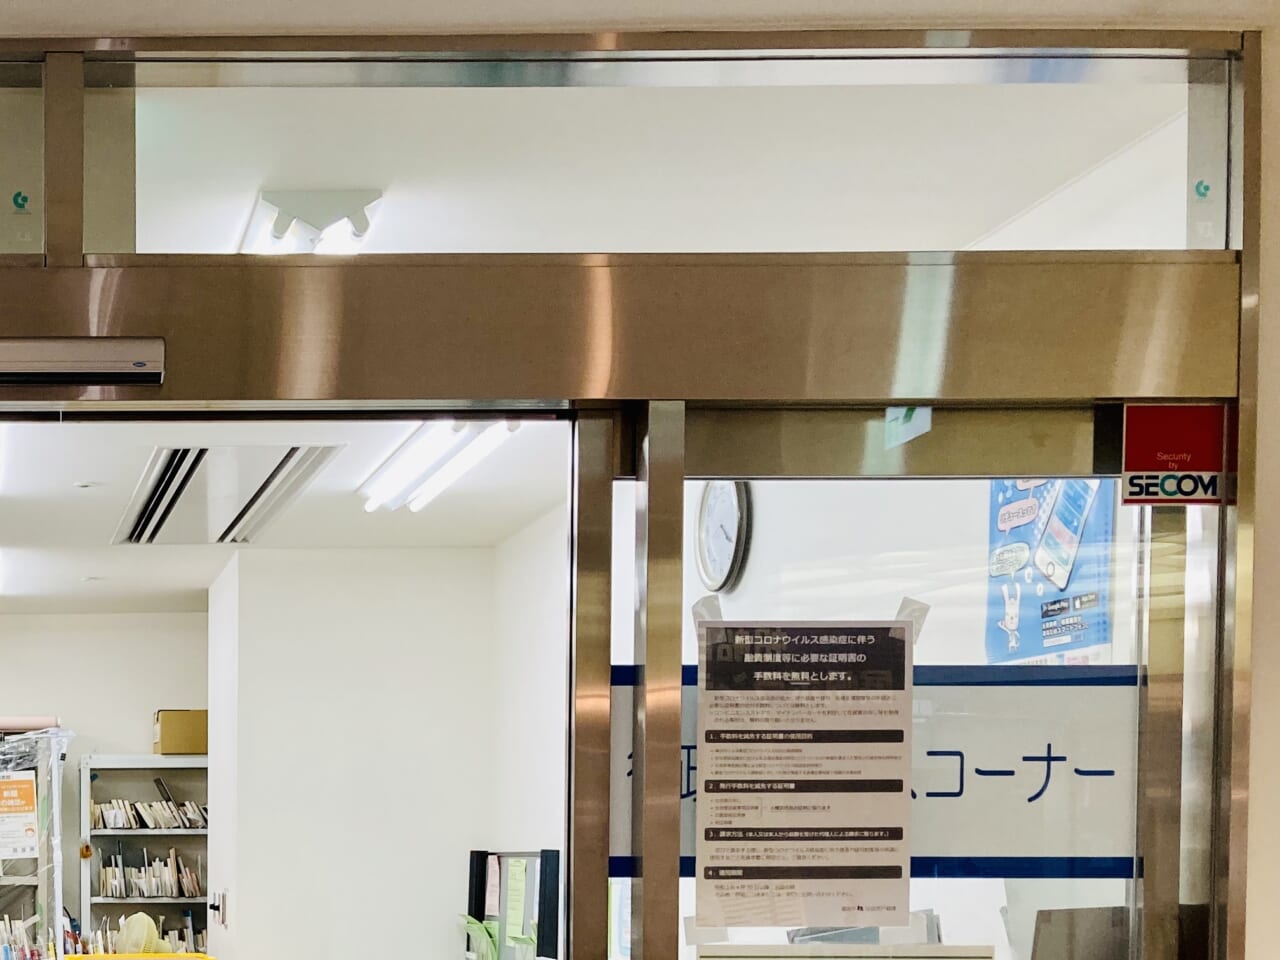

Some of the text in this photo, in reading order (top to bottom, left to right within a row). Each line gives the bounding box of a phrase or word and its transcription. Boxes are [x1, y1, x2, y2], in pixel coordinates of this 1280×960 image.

[1156, 451, 1191, 462] Security
[1129, 474, 1217, 496] SECOM
[911, 743, 1115, 802] コーナー
